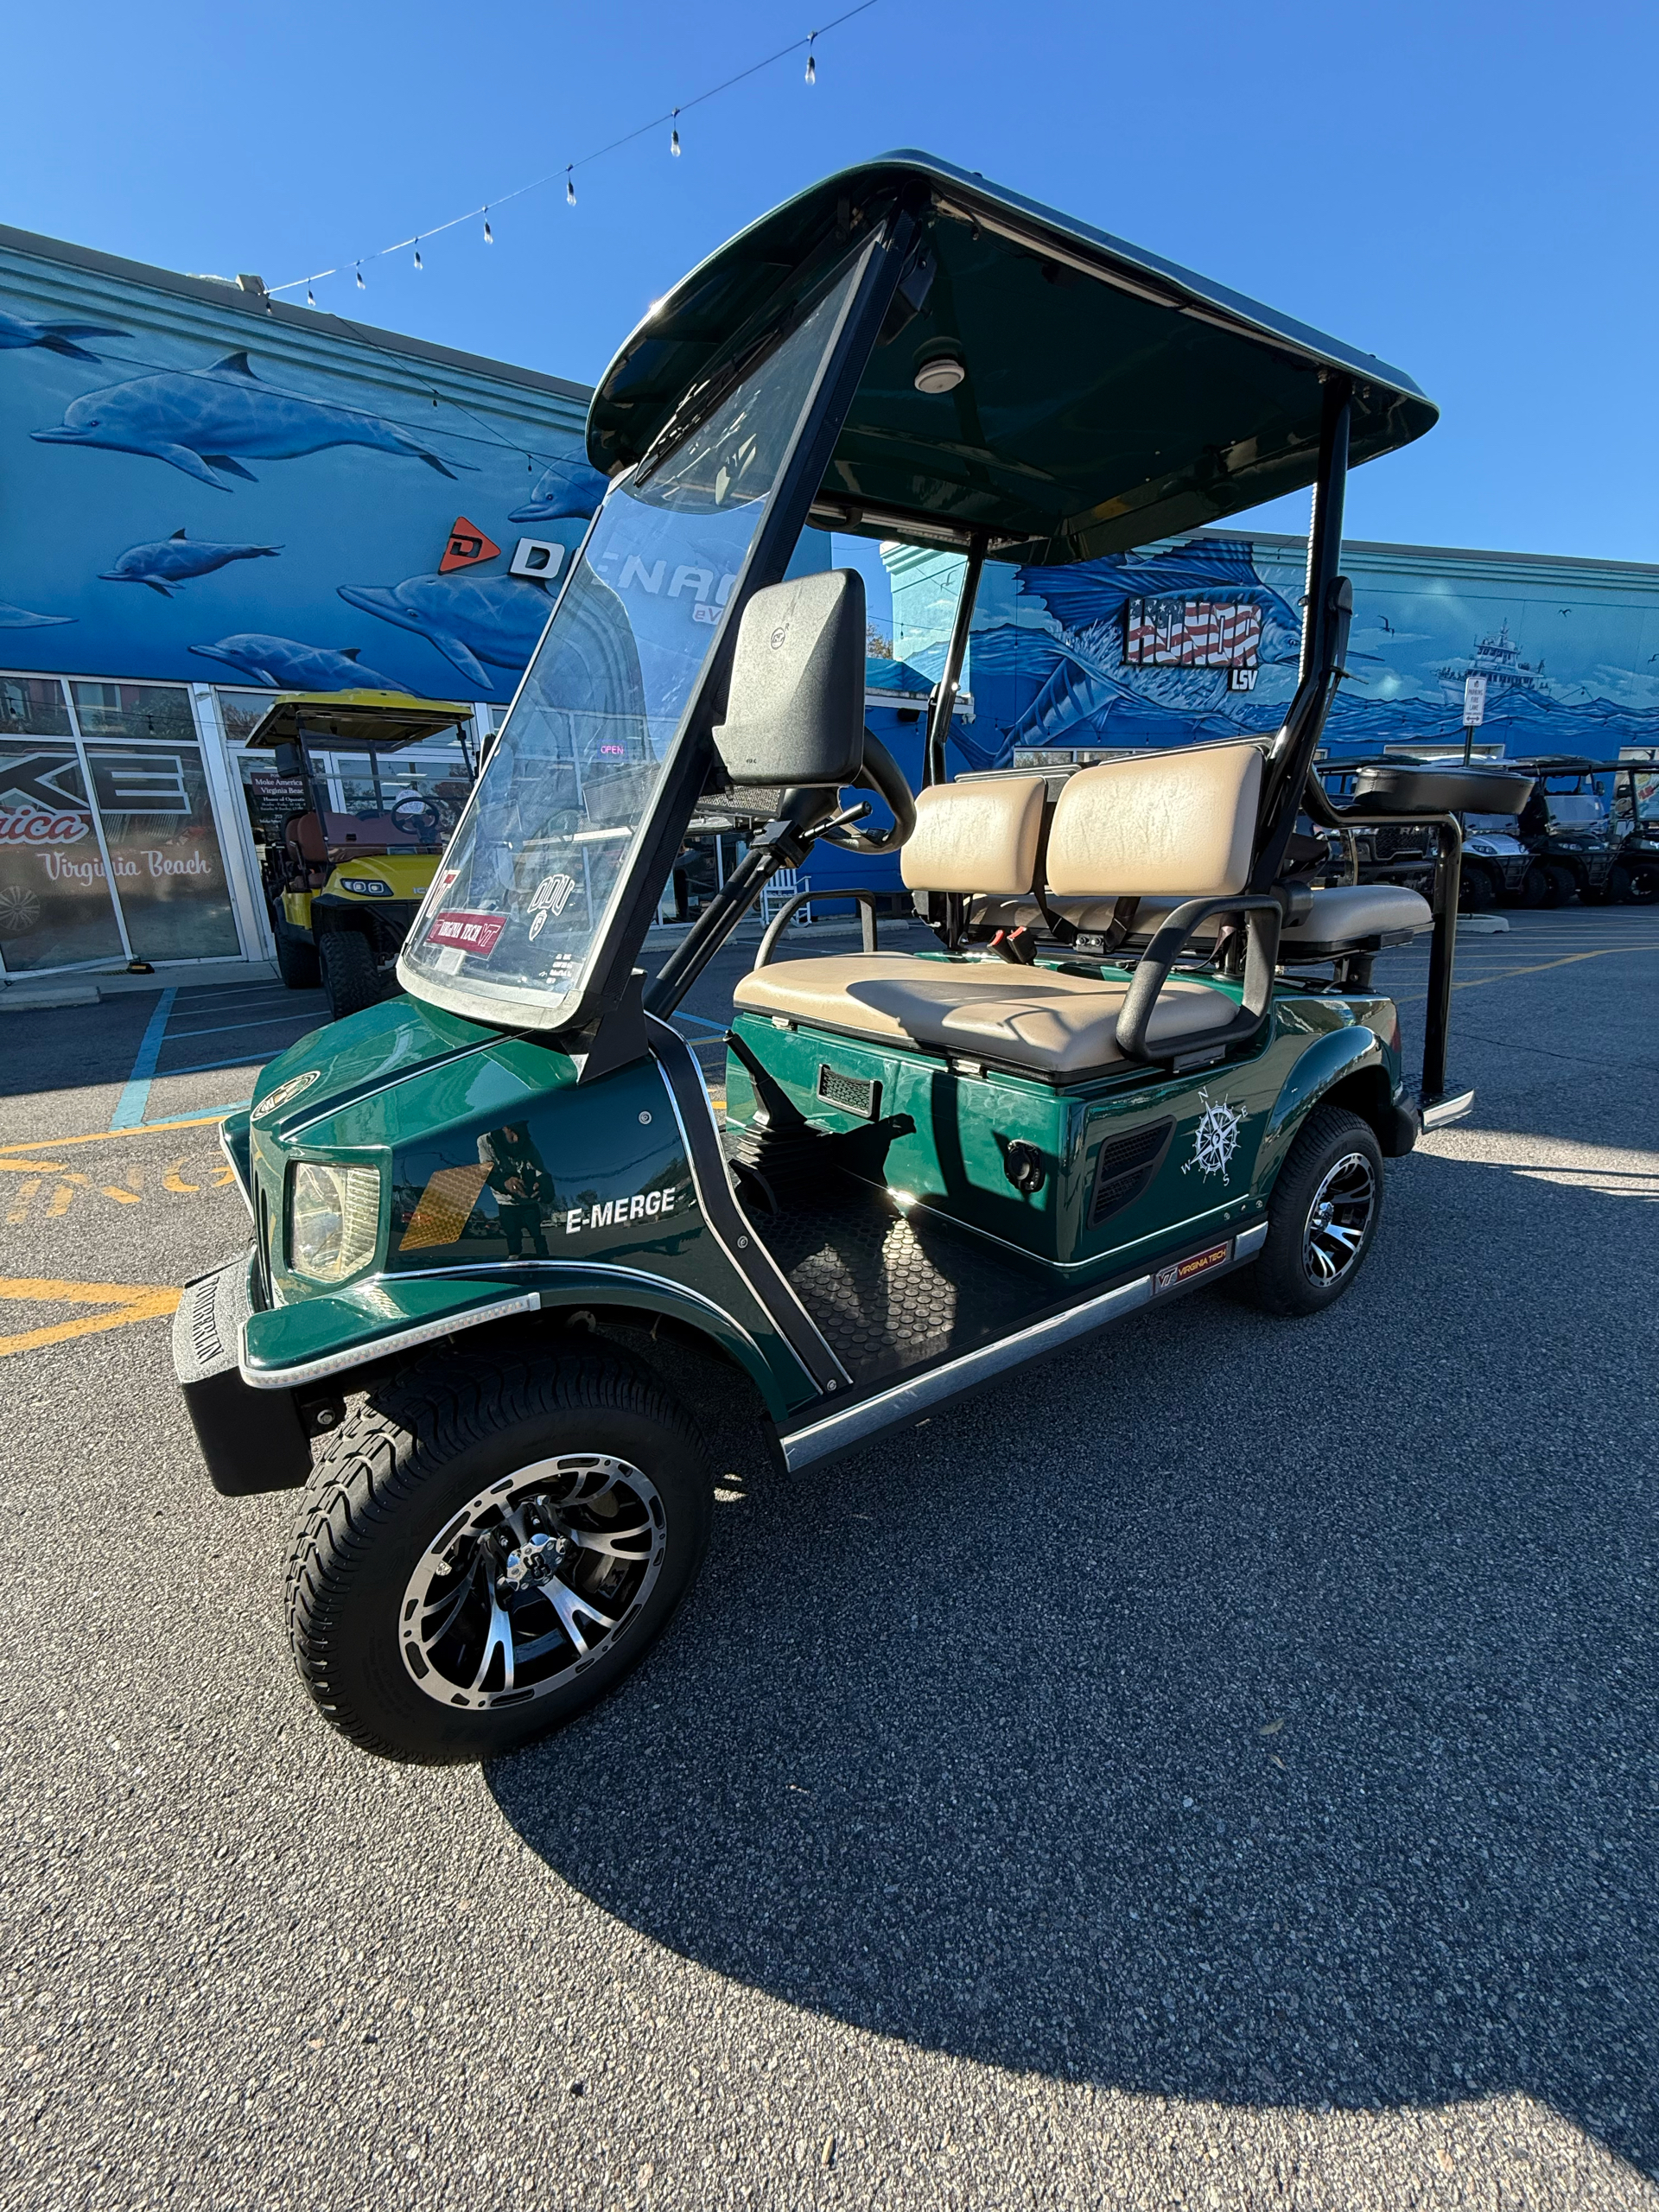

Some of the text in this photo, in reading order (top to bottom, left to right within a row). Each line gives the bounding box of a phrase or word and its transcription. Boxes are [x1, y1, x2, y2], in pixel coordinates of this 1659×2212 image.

[1126, 597, 1262, 668] HONOR
[1231, 669, 1258, 690] LSV
[600, 745, 624, 754] OPEN
[141, 850, 212, 878] Beach
[438, 921, 464, 939] VIRGINIA
[460, 923, 483, 943] TECH
[1241, 1105, 1249, 1118] E
[1180, 1159, 1192, 1175] W
[1223, 1173, 1230, 1187] S
[565, 1186, 676, 1235] E-MERGE
[1178, 1256, 1209, 1276] VIRGINIA
[1208, 1249, 1226, 1263] TECH
[192, 1275, 225, 1365] TOMBERLIN
